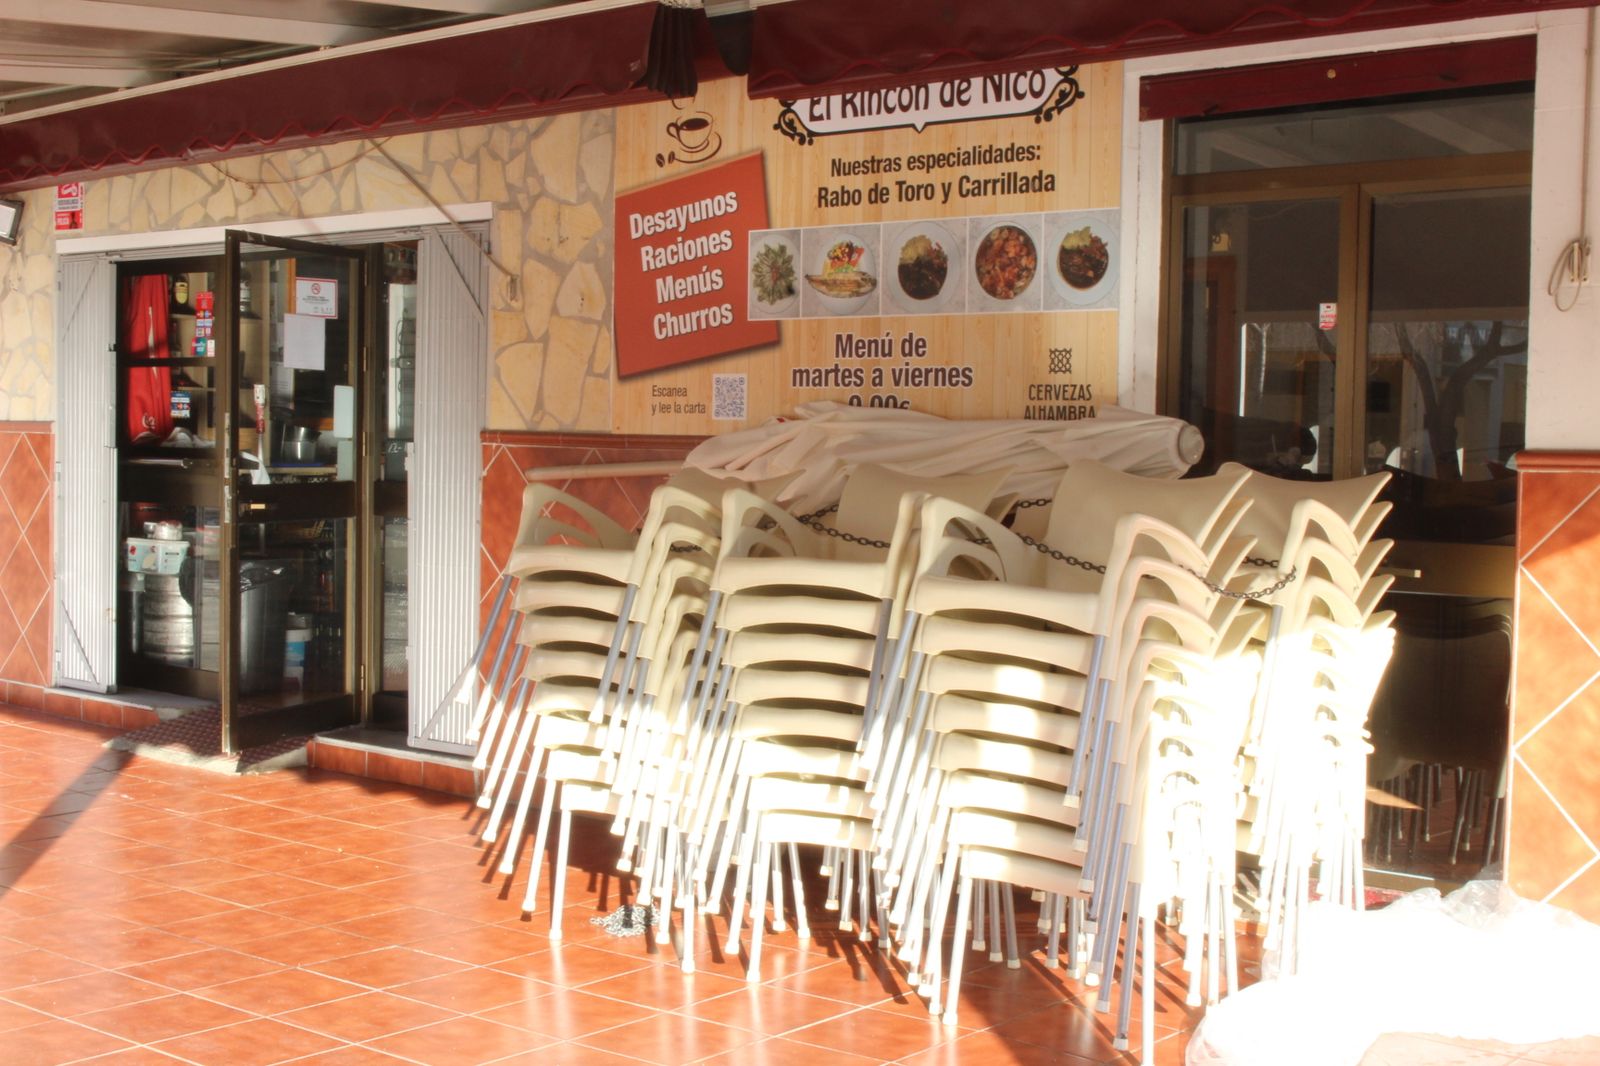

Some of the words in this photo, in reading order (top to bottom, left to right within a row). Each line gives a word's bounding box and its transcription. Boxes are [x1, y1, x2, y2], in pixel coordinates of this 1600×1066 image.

[939, 79, 972, 108] de
[982, 69, 1046, 103] Nico
[831, 156, 901, 177] Nuestras
[907, 143, 1041, 173] especialidades:
[817, 185, 862, 208] Rabo
[868, 183, 889, 204] de
[895, 180, 934, 202] Toro
[941, 181, 952, 204] y
[958, 170, 1056, 198] Carrillada
[629, 191, 738, 240] Desayunos
[640, 230, 733, 273] Raciones
[655, 265, 724, 304] Menús
[653, 303, 733, 340] Churros
[835, 332, 893, 359] Menú
[901, 332, 927, 358] de
[652, 385, 687, 397] Escanea
[792, 363, 864, 387] martes
[871, 367, 883, 387] a
[891, 362, 973, 387] viernes
[651, 404, 657, 416] y
[658, 402, 671, 414] lee
[673, 402, 682, 414] la
[683, 403, 706, 414] carta
[1028, 384, 1092, 401] CERVEZAS
[1024, 404, 1096, 421] ALHAMBRA
